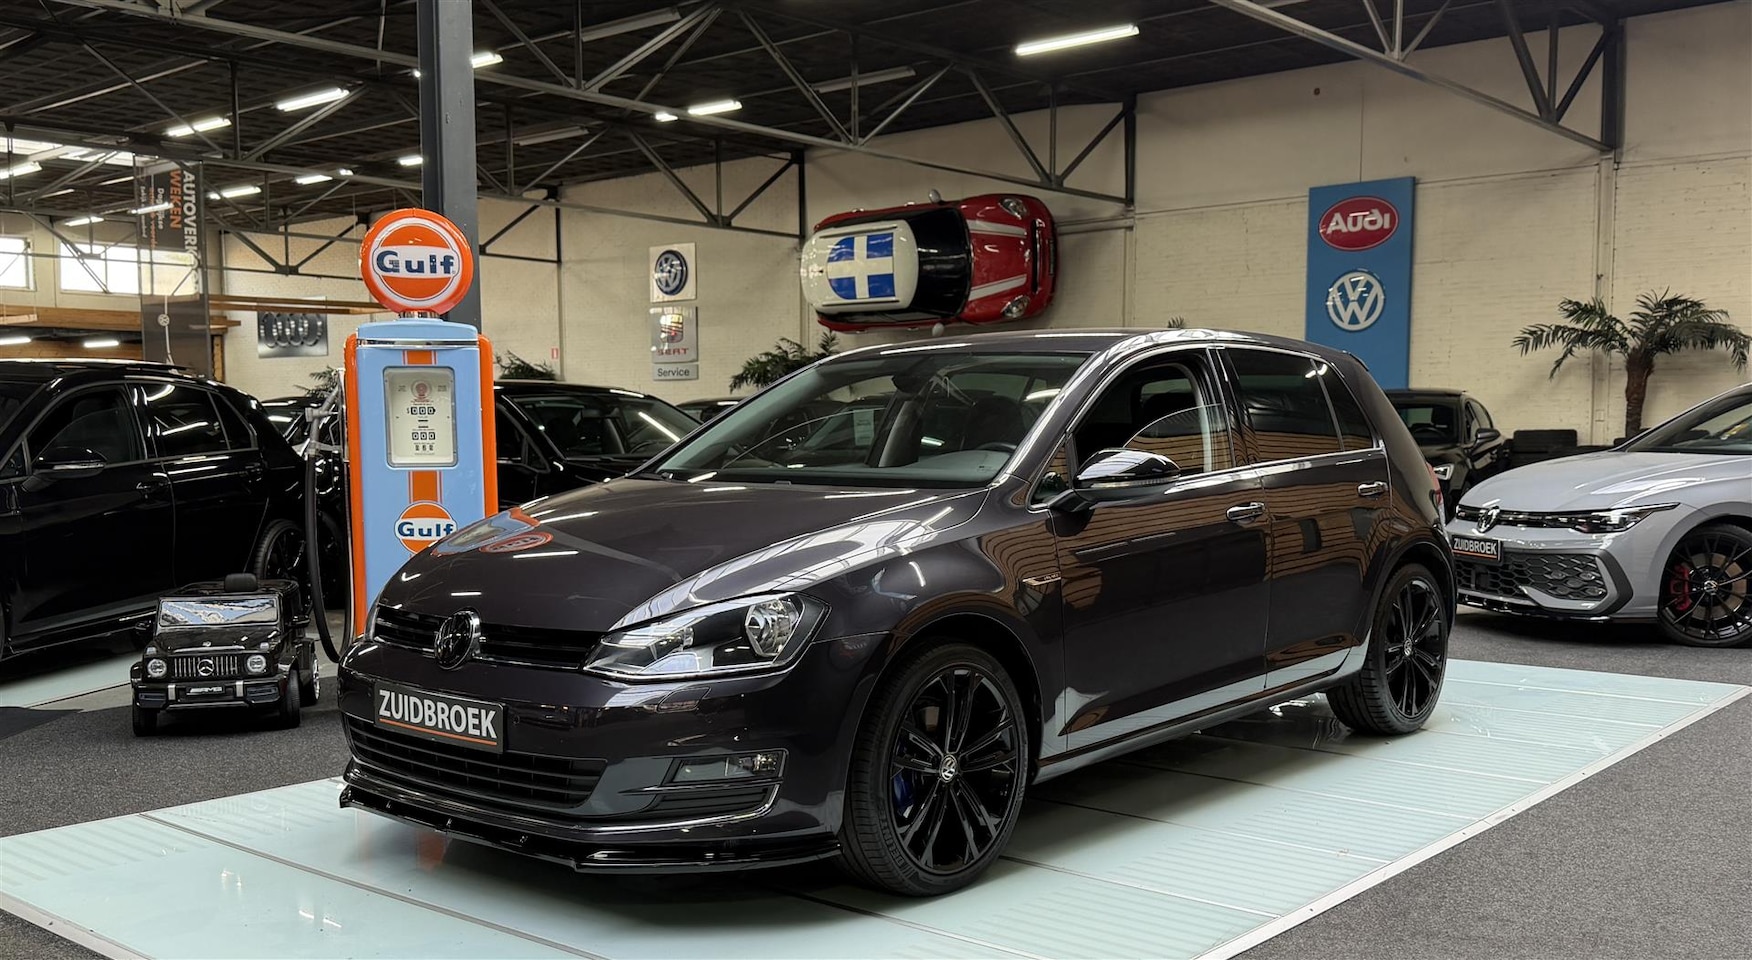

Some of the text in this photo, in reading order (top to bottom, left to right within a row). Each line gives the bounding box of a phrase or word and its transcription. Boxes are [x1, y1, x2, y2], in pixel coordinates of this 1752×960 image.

[170, 170, 182, 229] WEKEN
[376, 249, 454, 275] Gulf
[657, 347, 689, 356] SEAT
[657, 367, 690, 377] Service
[397, 521, 454, 537] Gulf
[1453, 537, 1497, 555] ZUIDBROEK
[378, 688, 498, 739] ZUIDBROEK
